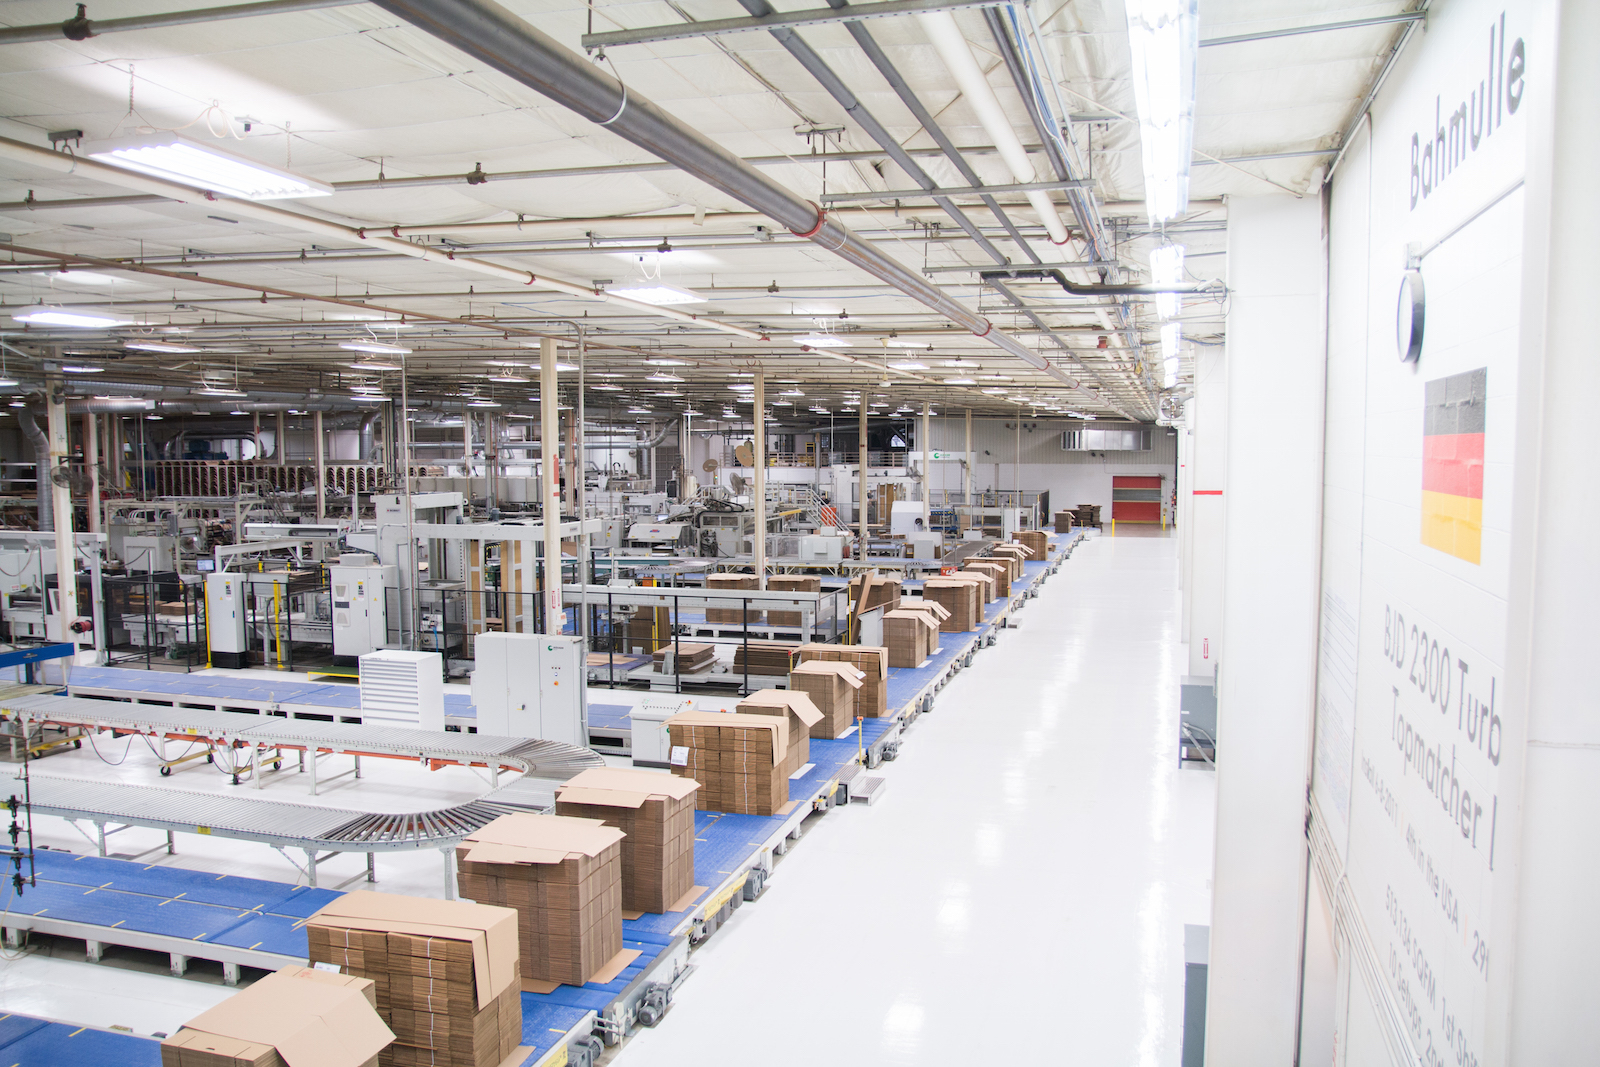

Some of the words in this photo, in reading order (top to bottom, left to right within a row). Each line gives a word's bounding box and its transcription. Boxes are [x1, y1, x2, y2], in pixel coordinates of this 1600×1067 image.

[1409, 624, 1451, 715] 2300
[1392, 685, 1482, 849] Topmatcher
[1426, 855, 1439, 897] the
[1442, 879, 1459, 933] USA
[1397, 962, 1422, 1040] Setups
[1426, 1028, 1444, 1067] 2n
[1442, 996, 1455, 1049] 1st
